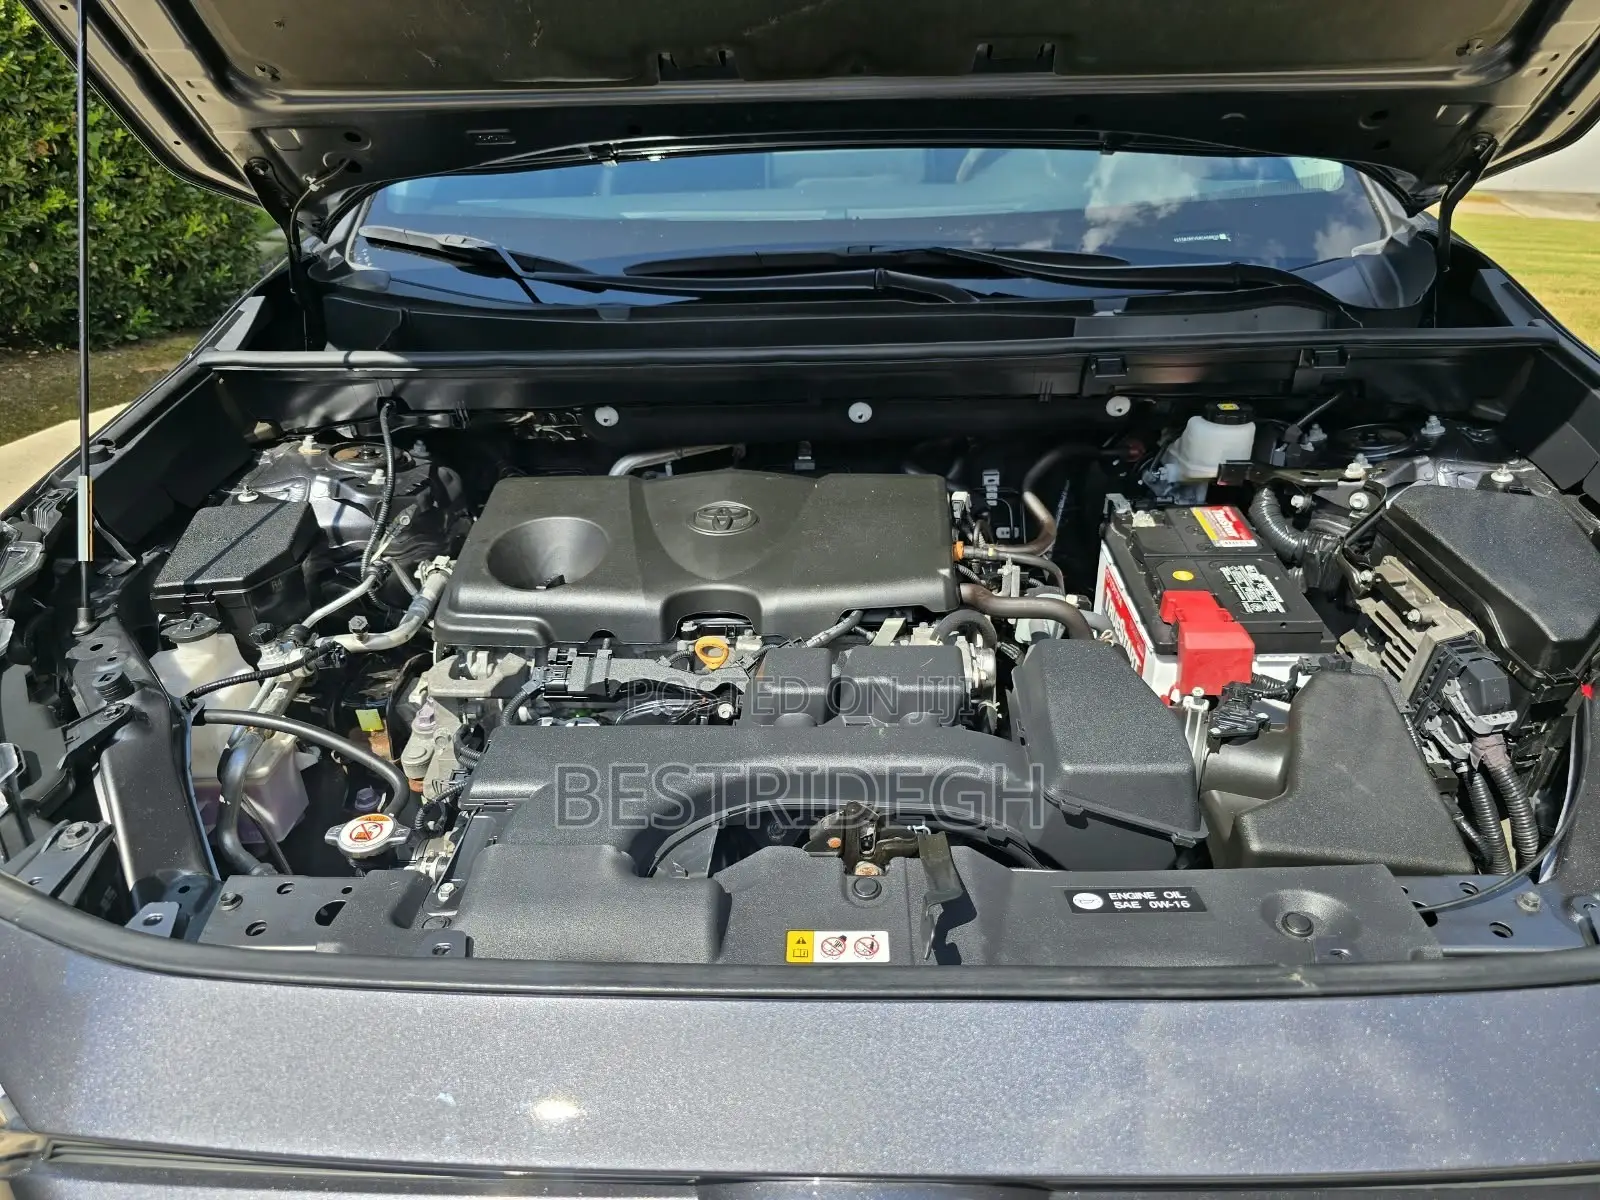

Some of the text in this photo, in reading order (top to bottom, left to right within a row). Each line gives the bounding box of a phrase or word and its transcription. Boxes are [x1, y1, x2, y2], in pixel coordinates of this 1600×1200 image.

[1108, 890, 1187, 900] ENGINE OIL
[1114, 900, 1191, 909] SAE 0W-16
